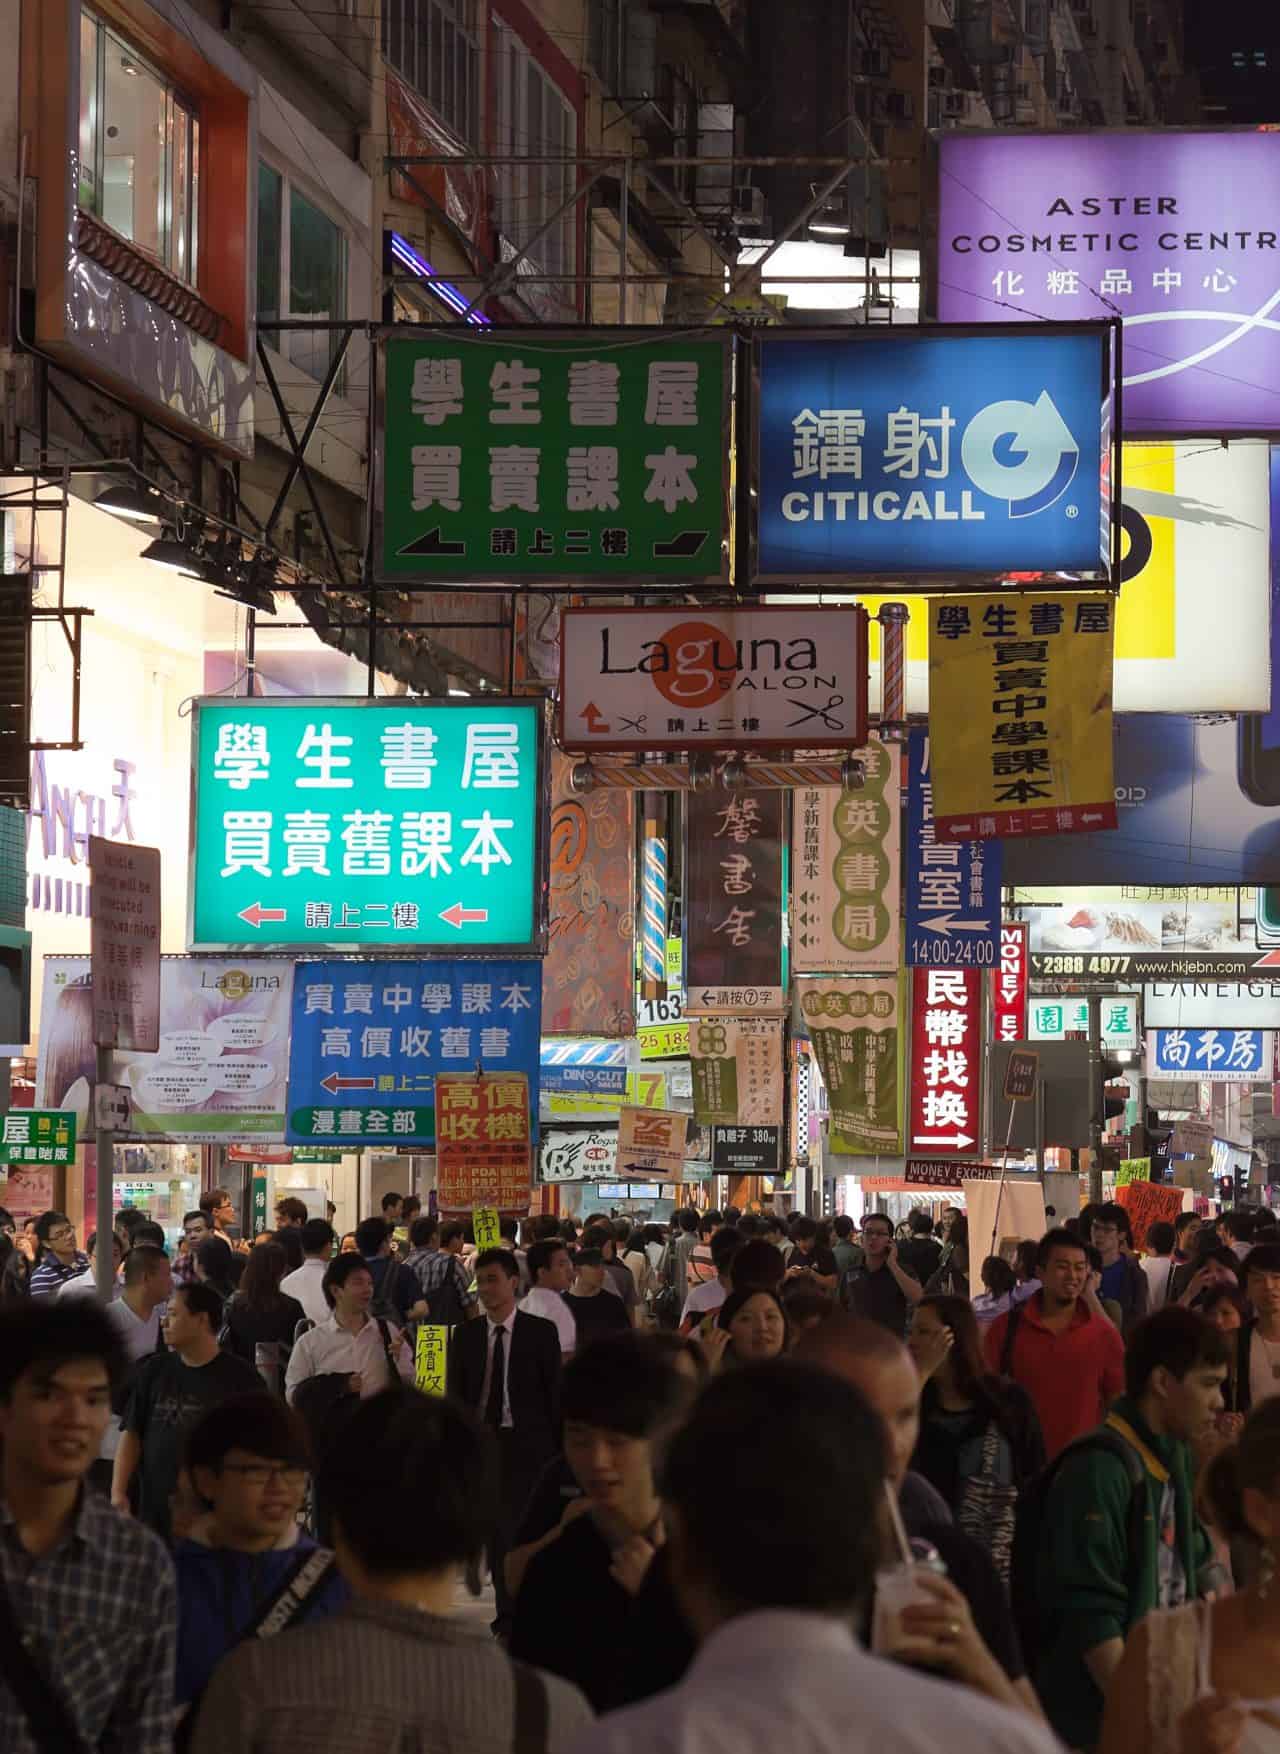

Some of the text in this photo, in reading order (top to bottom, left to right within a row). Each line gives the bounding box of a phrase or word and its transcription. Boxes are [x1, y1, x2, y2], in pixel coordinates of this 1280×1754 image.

[1047, 196, 1179, 217] ASTER
[951, 232, 1139, 253] COSMETIC
[991, 269, 1237, 296] 化粧品中心
[409, 357, 699, 428] 學生書屋
[791, 406, 956, 481] 鐳射
[410, 445, 699, 514] 買賣課本
[781, 491, 985, 520] CITICALL
[490, 528, 628, 557] 請上二樓
[937, 602, 1110, 639] 學生書屋
[599, 627, 817, 698] Laguna
[718, 676, 836, 690] SALON
[667, 718, 761, 732] 請上二樓
[992, 641, 1052, 803] 買賣中學課本
[213, 722, 522, 792] 學生書屋
[978, 811, 1074, 836] 請上二樓
[219, 810, 515, 880] 買賣舊課本
[304, 902, 419, 929] 請上二樓
[912, 939, 994, 964] 14:00-24:00
[1000, 929, 1023, 1004] MONEY
[201, 970, 280, 999] Laguna
[304, 982, 532, 1015] 買賣中學課本
[320, 1026, 510, 1058] 高價收舊書
[922, 970, 969, 1128] 民幣找換
[378, 1074, 436, 1092] 請上二
[441, 1082, 527, 1111] 高價
[2, 1116, 30, 1144] 屋
[311, 1110, 416, 1134] 漫畫全部
[440, 1112, 527, 1141] 收機
[911, 1161, 952, 1177] MONEY
[474, 1208, 497, 1250] 高價
